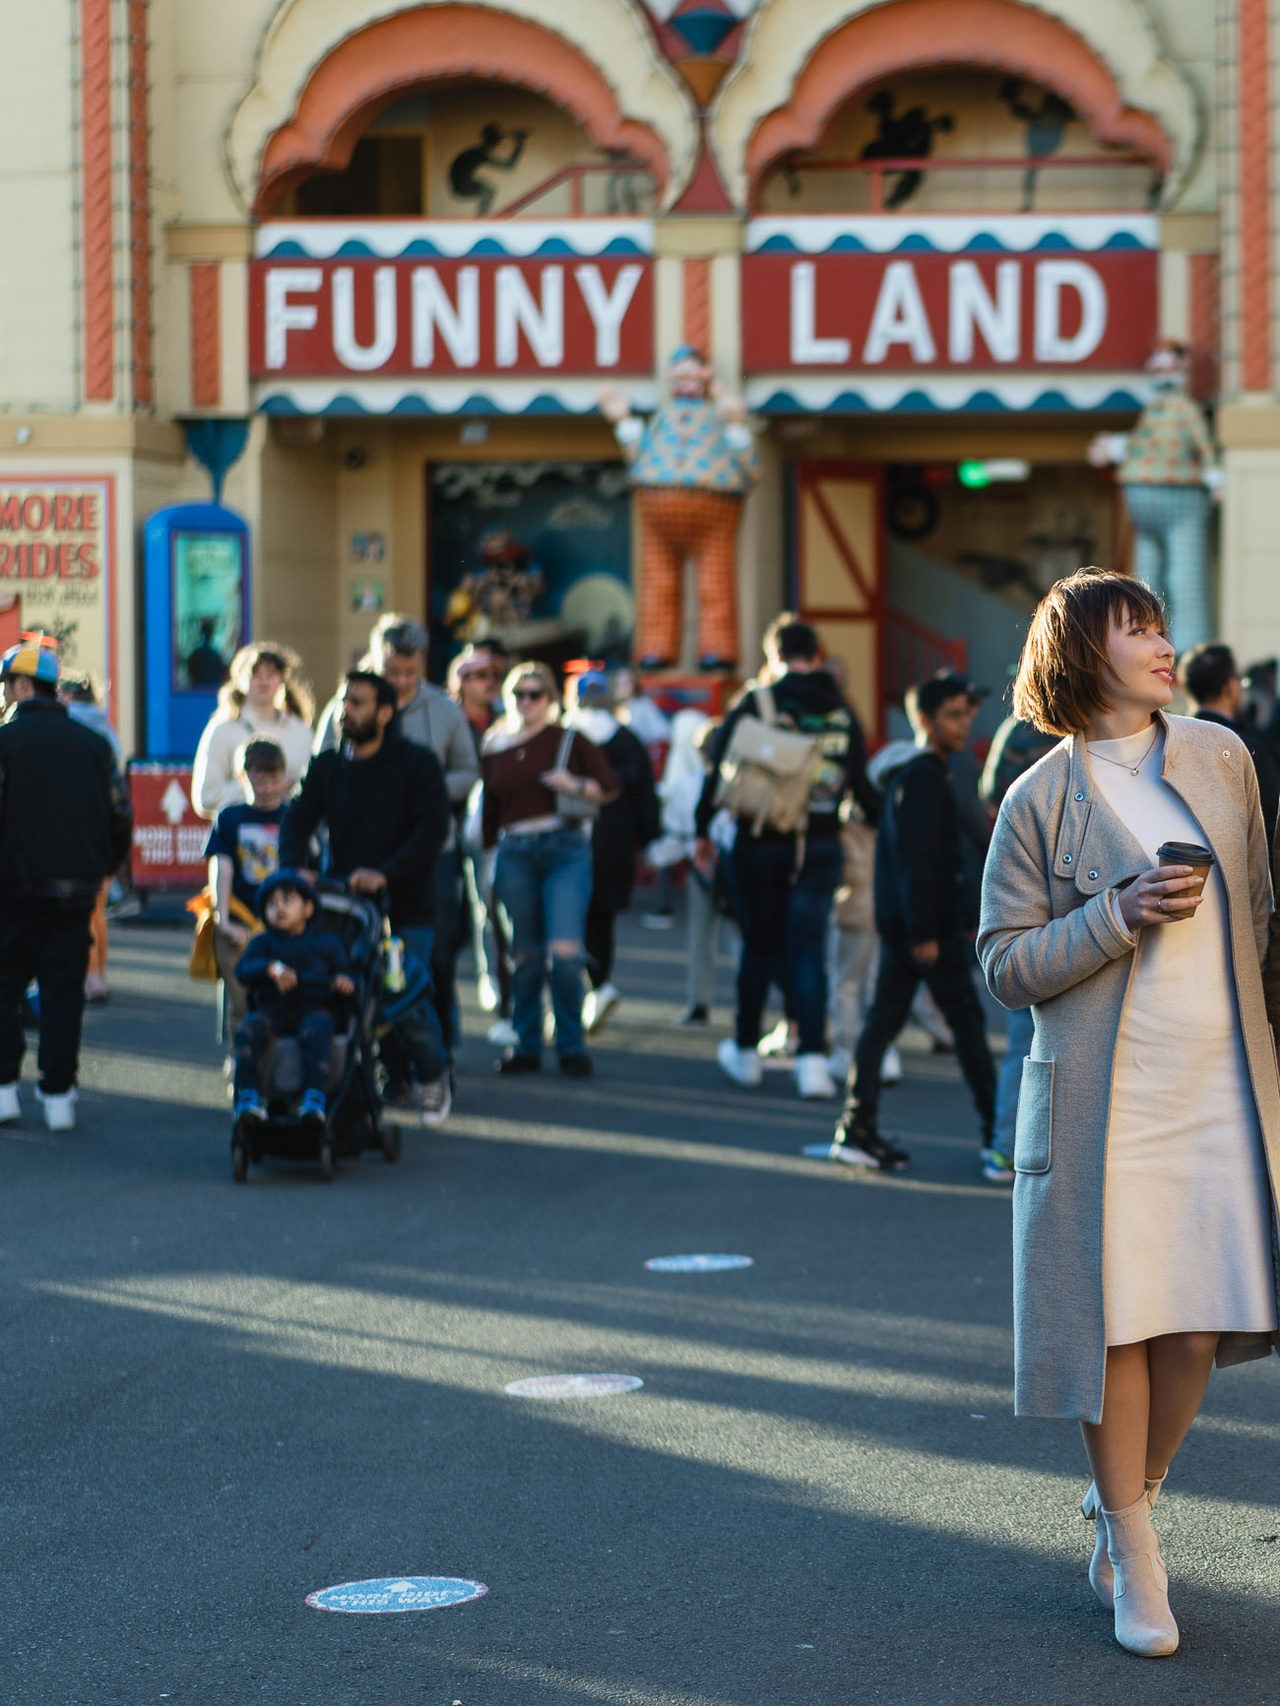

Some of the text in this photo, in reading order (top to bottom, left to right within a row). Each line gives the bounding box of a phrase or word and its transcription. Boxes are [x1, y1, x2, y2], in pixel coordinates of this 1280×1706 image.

[265, 265, 644, 372] FUNNY
[791, 260, 1108, 365] LAND
[0, 495, 97, 532] MORE
[0, 542, 99, 580] RIDES
[328, 1590, 467, 1601] MORE RIDES
